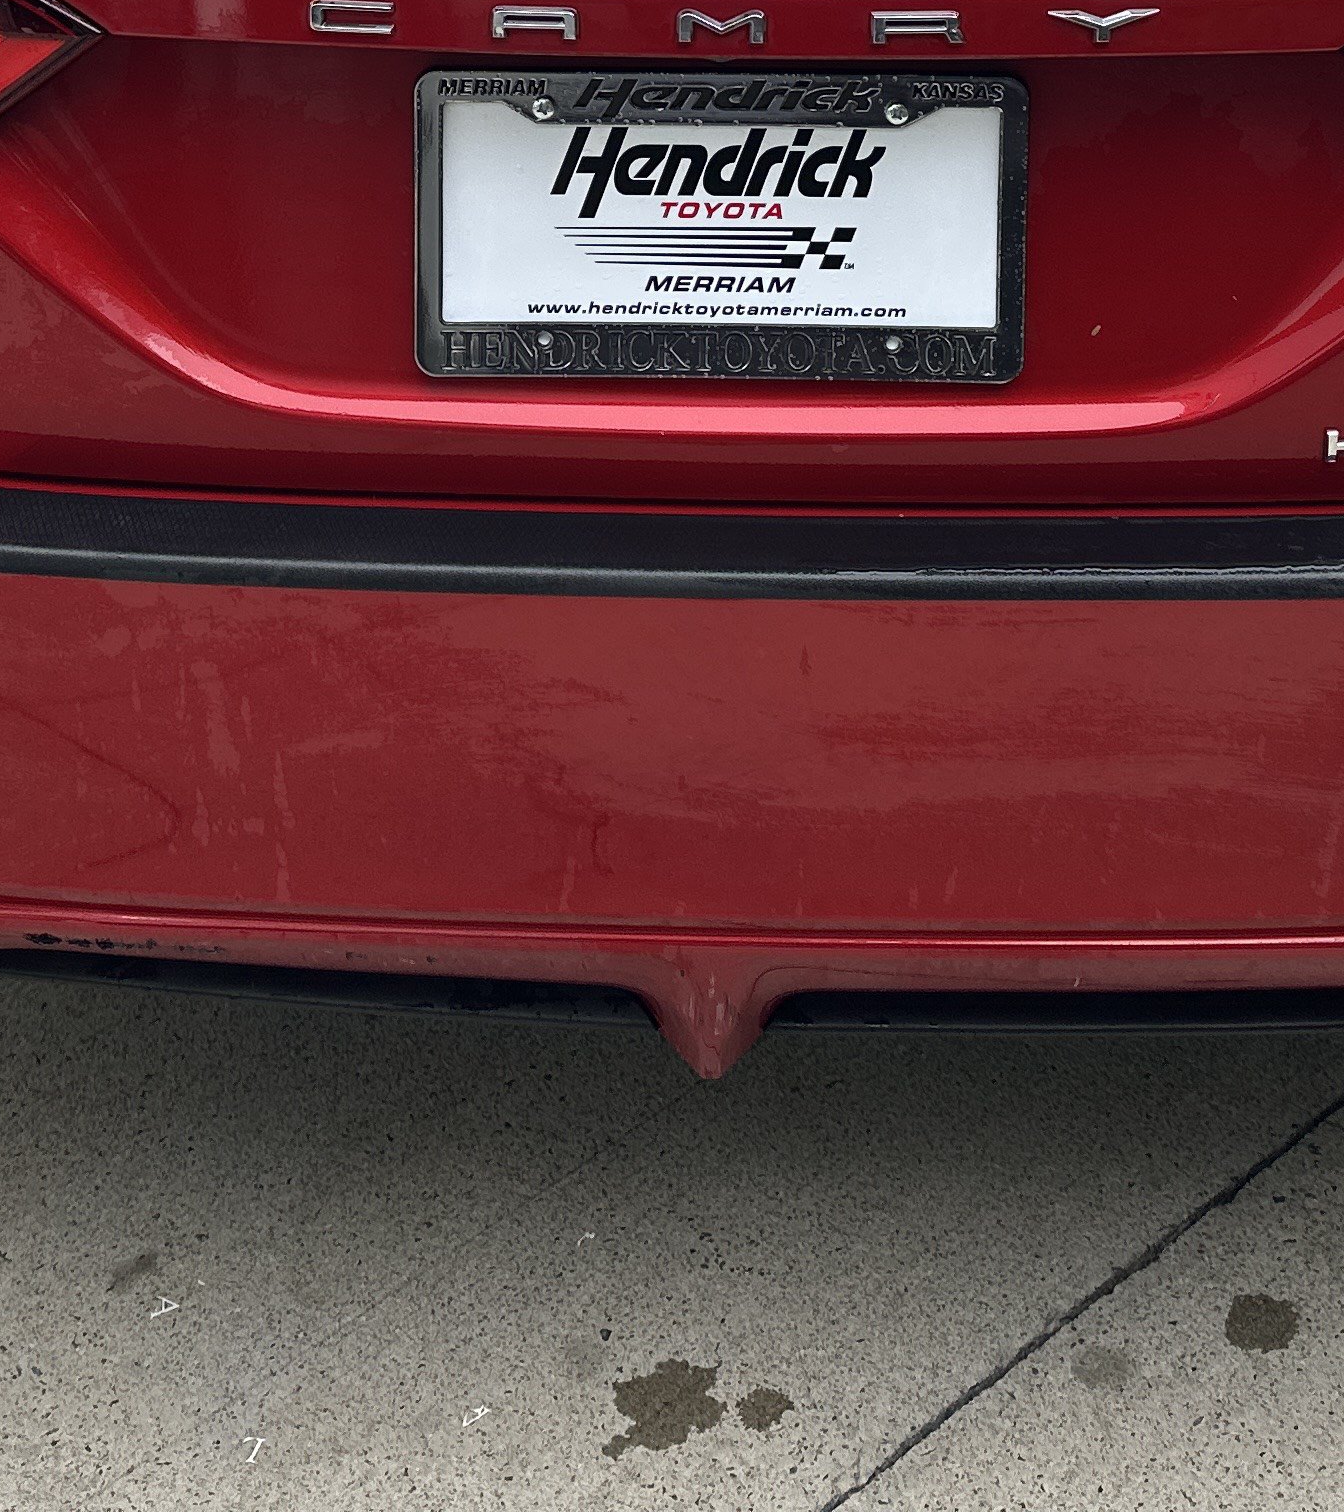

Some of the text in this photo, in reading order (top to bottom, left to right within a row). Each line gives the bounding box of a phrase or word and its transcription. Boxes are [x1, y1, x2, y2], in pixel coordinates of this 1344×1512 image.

[438, 77, 547, 97] MERRIAM
[912, 82, 1005, 102] KANSAS
[572, 77, 880, 118] Hendrick
[550, 126, 887, 219] Hendrick
[660, 201, 784, 220] TOYOTA
[644, 275, 797, 294] MERRIAM
[527, 301, 908, 319] www.hendricktoyotamerriam.com
[440, 329, 998, 378] HENDRICKTOYOTA.COM
